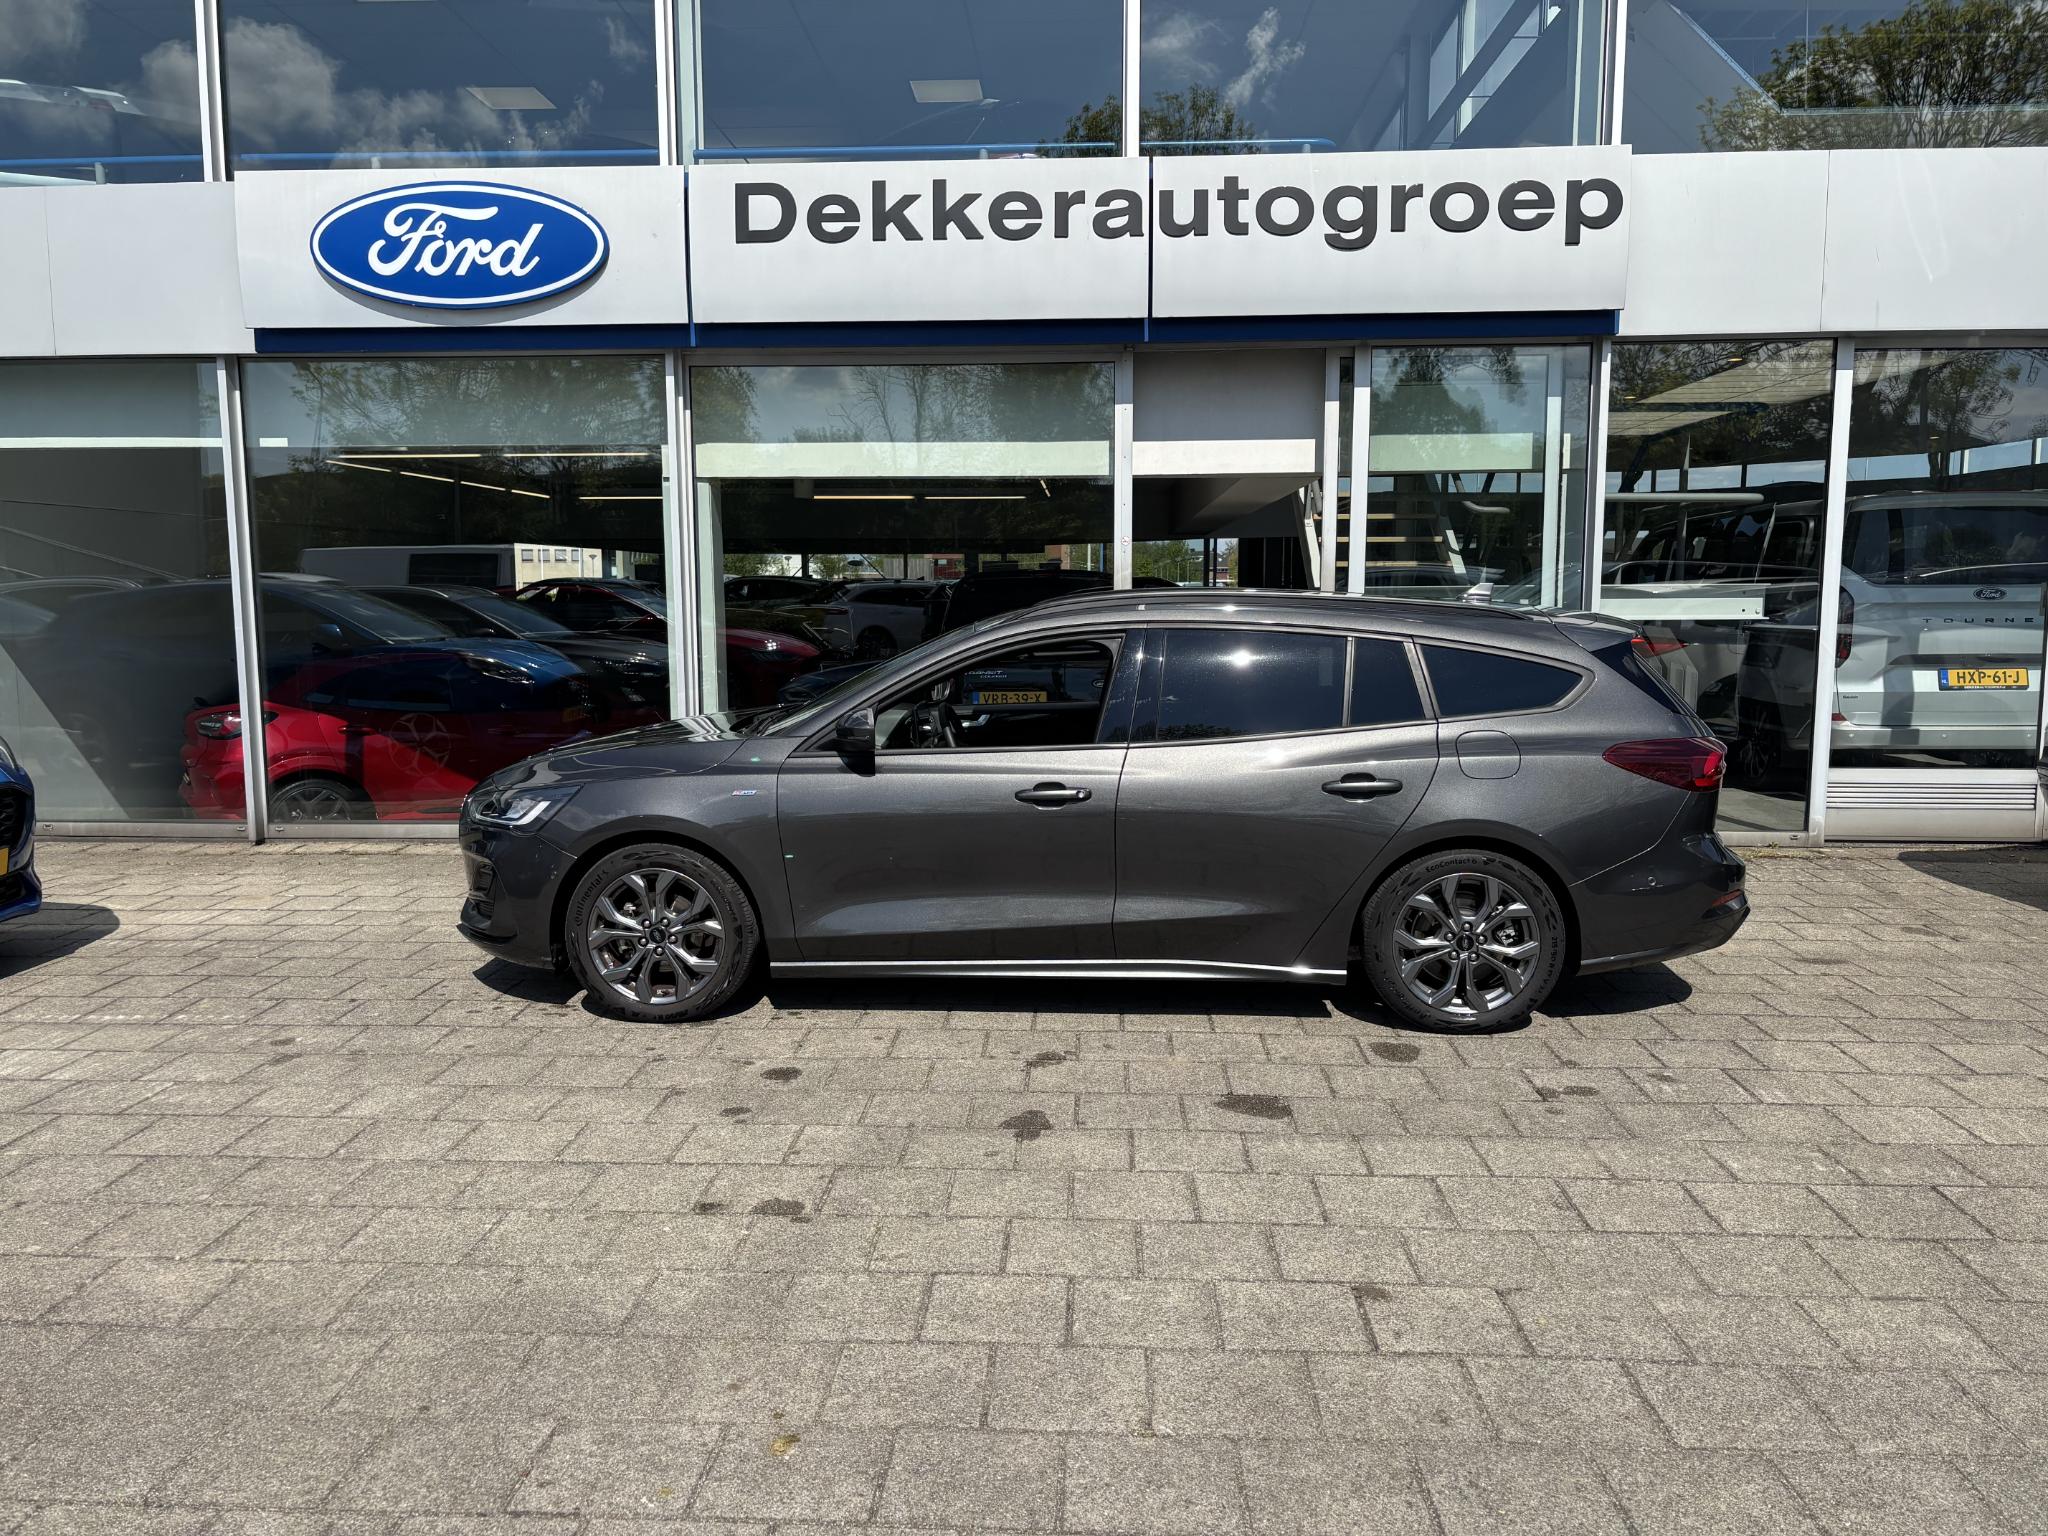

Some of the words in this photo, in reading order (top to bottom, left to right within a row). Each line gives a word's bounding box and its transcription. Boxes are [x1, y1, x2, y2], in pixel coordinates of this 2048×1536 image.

[734, 175, 1624, 252] Dekkerautogroep
[367, 202, 545, 277] Ford
[982, 693, 1042, 705] VRB-39-X
[1956, 670, 2021, 685] HXP-61-J
